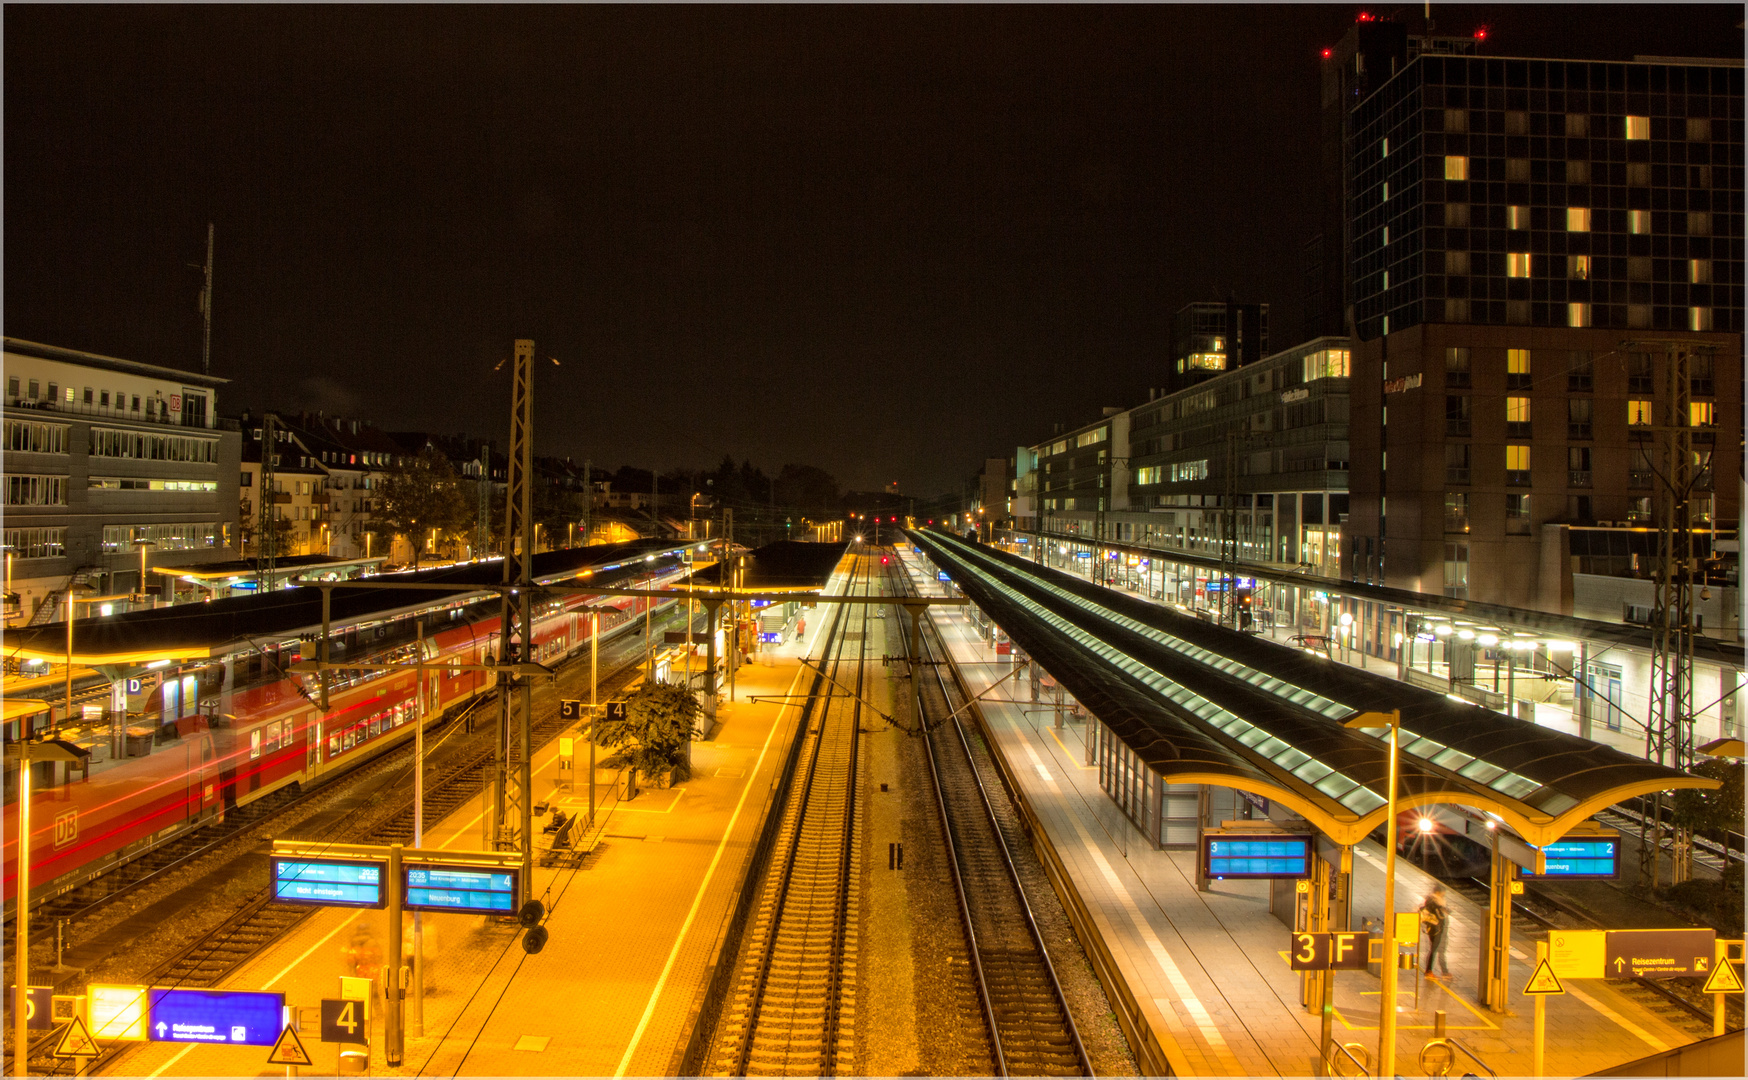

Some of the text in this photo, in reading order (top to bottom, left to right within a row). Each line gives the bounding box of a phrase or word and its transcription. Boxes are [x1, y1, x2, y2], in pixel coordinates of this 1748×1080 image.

[378, 628, 384, 637] 6
[130, 680, 140, 692] D
[563, 702, 572, 716] 5
[614, 703, 623, 718] 4
[56, 812, 76, 844] DB
[1211, 842, 1218, 852] 3
[1606, 844, 1613, 854] 2
[278, 864, 285, 874] 5
[504, 876, 510, 886] 4
[314, 888, 343, 896] einsteigen
[429, 894, 460, 904] Neuenburg
[1296, 934, 1315, 963] 3
[1337, 934, 1354, 962] F
[336, 1002, 357, 1034] 4
